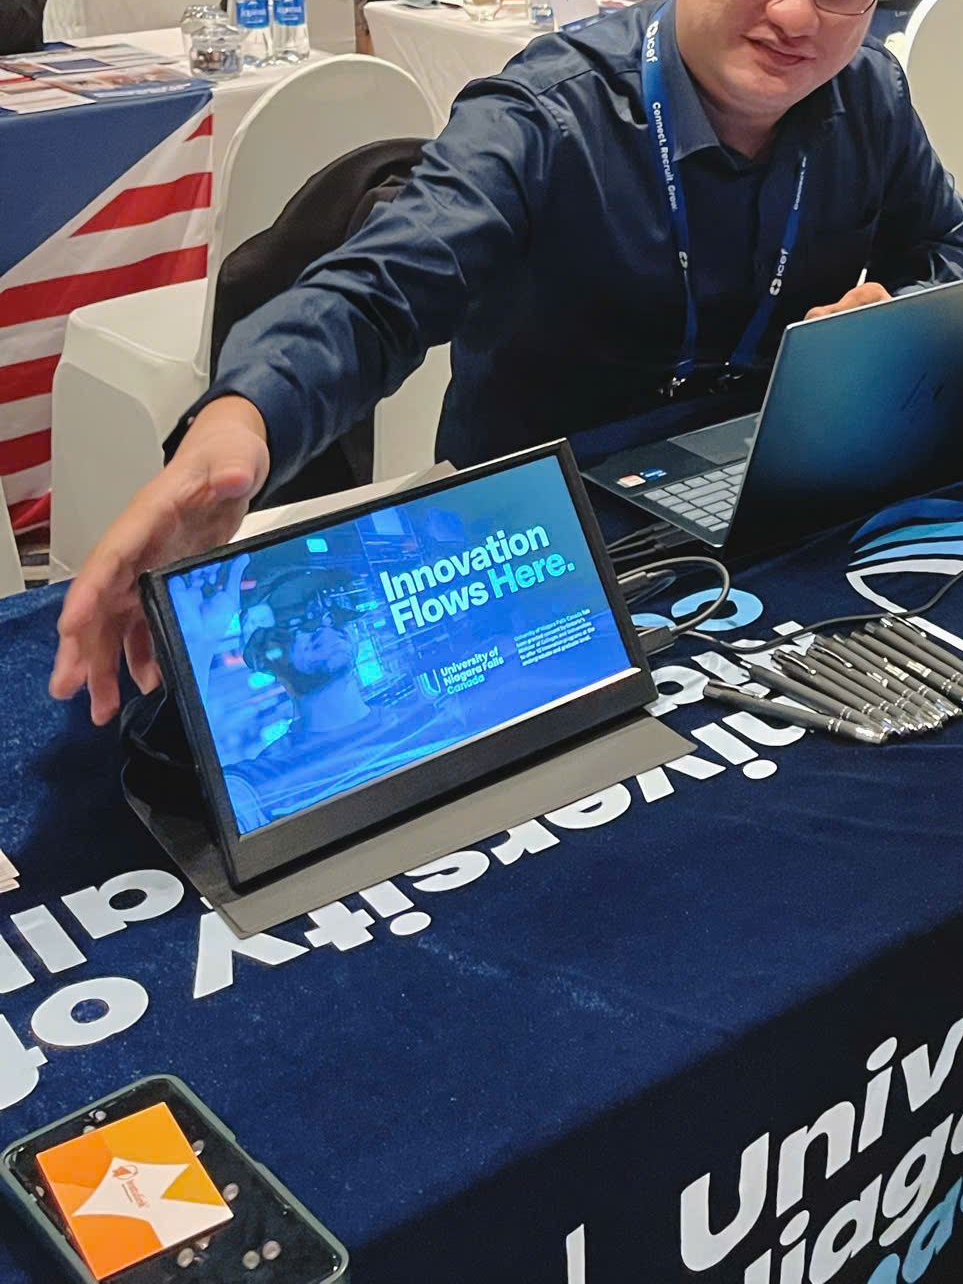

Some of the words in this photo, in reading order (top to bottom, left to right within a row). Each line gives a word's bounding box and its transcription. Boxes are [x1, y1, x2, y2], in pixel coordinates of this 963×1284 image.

[380, 525, 550, 603] Innovation
[389, 581, 489, 635] Flows
[487, 553, 575, 599] Here.
[440, 652, 489, 677] University
[489, 645, 498, 657] of
[443, 665, 483, 686] Niagara
[482, 656, 504, 671] Falls
[447, 674, 485, 695] Canada
